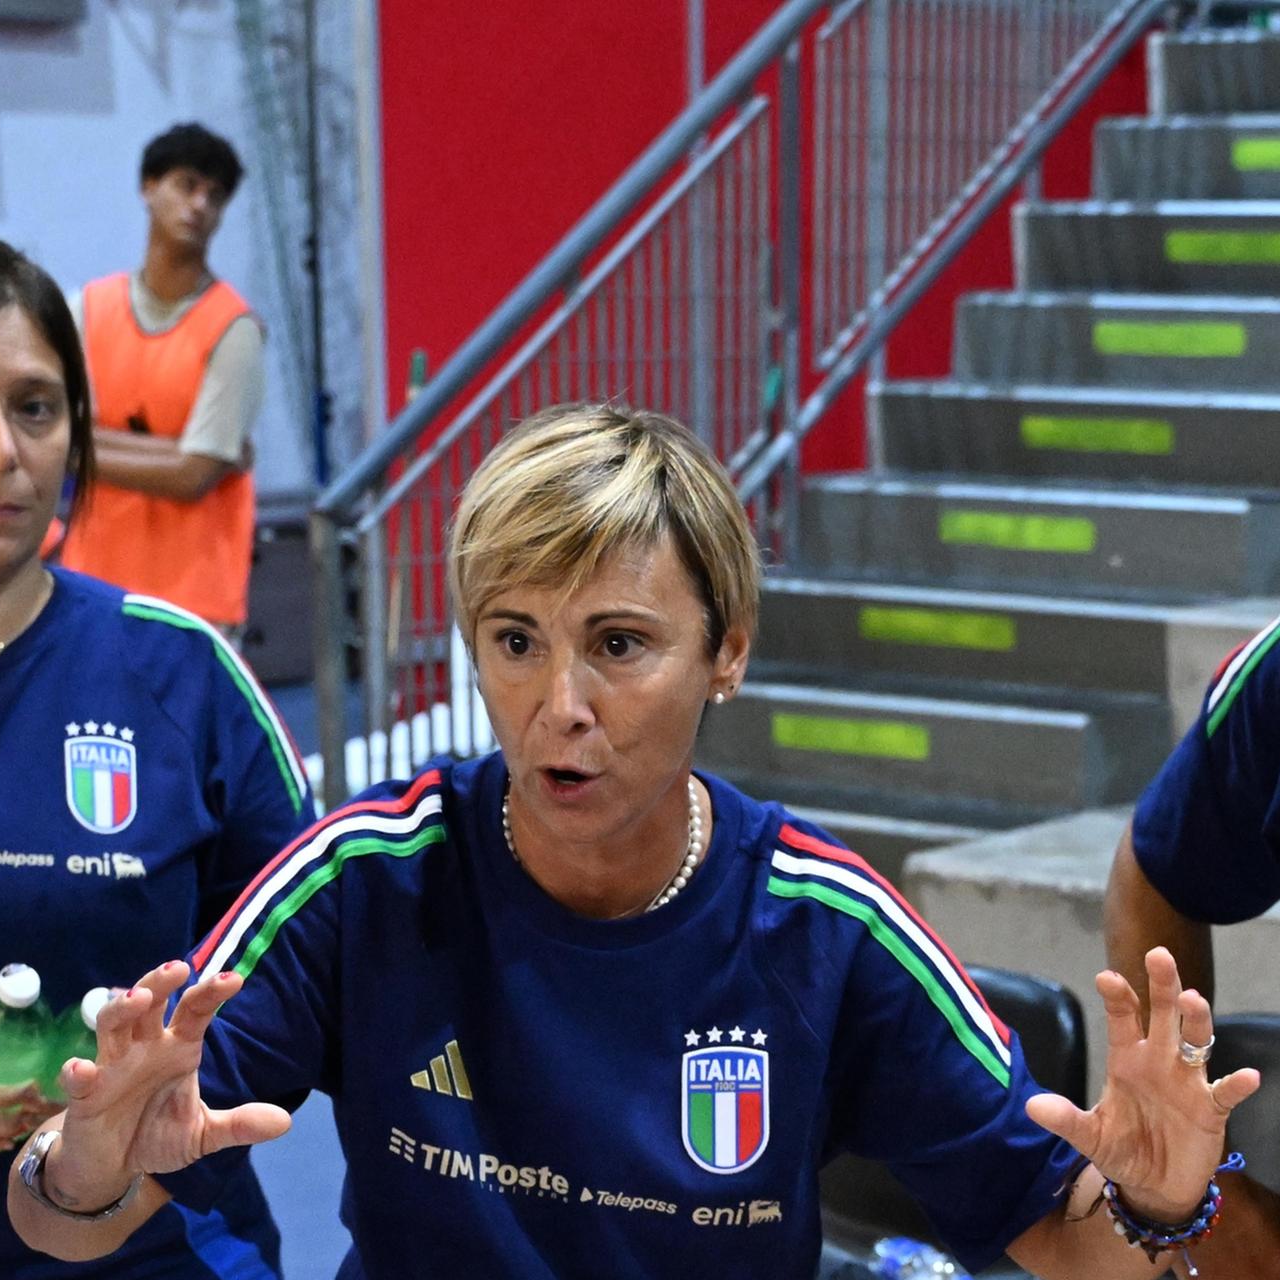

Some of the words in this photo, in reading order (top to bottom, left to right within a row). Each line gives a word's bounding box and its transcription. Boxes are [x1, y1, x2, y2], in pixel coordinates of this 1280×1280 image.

[71, 744, 130, 768] ITALIA
[66, 852, 111, 877] eni
[689, 1058, 762, 1082] ITALIA
[421, 1143, 474, 1181] TIM
[479, 1153, 569, 1195] Poste
[596, 1190, 678, 1215] Telepass
[692, 1201, 746, 1226] eni
